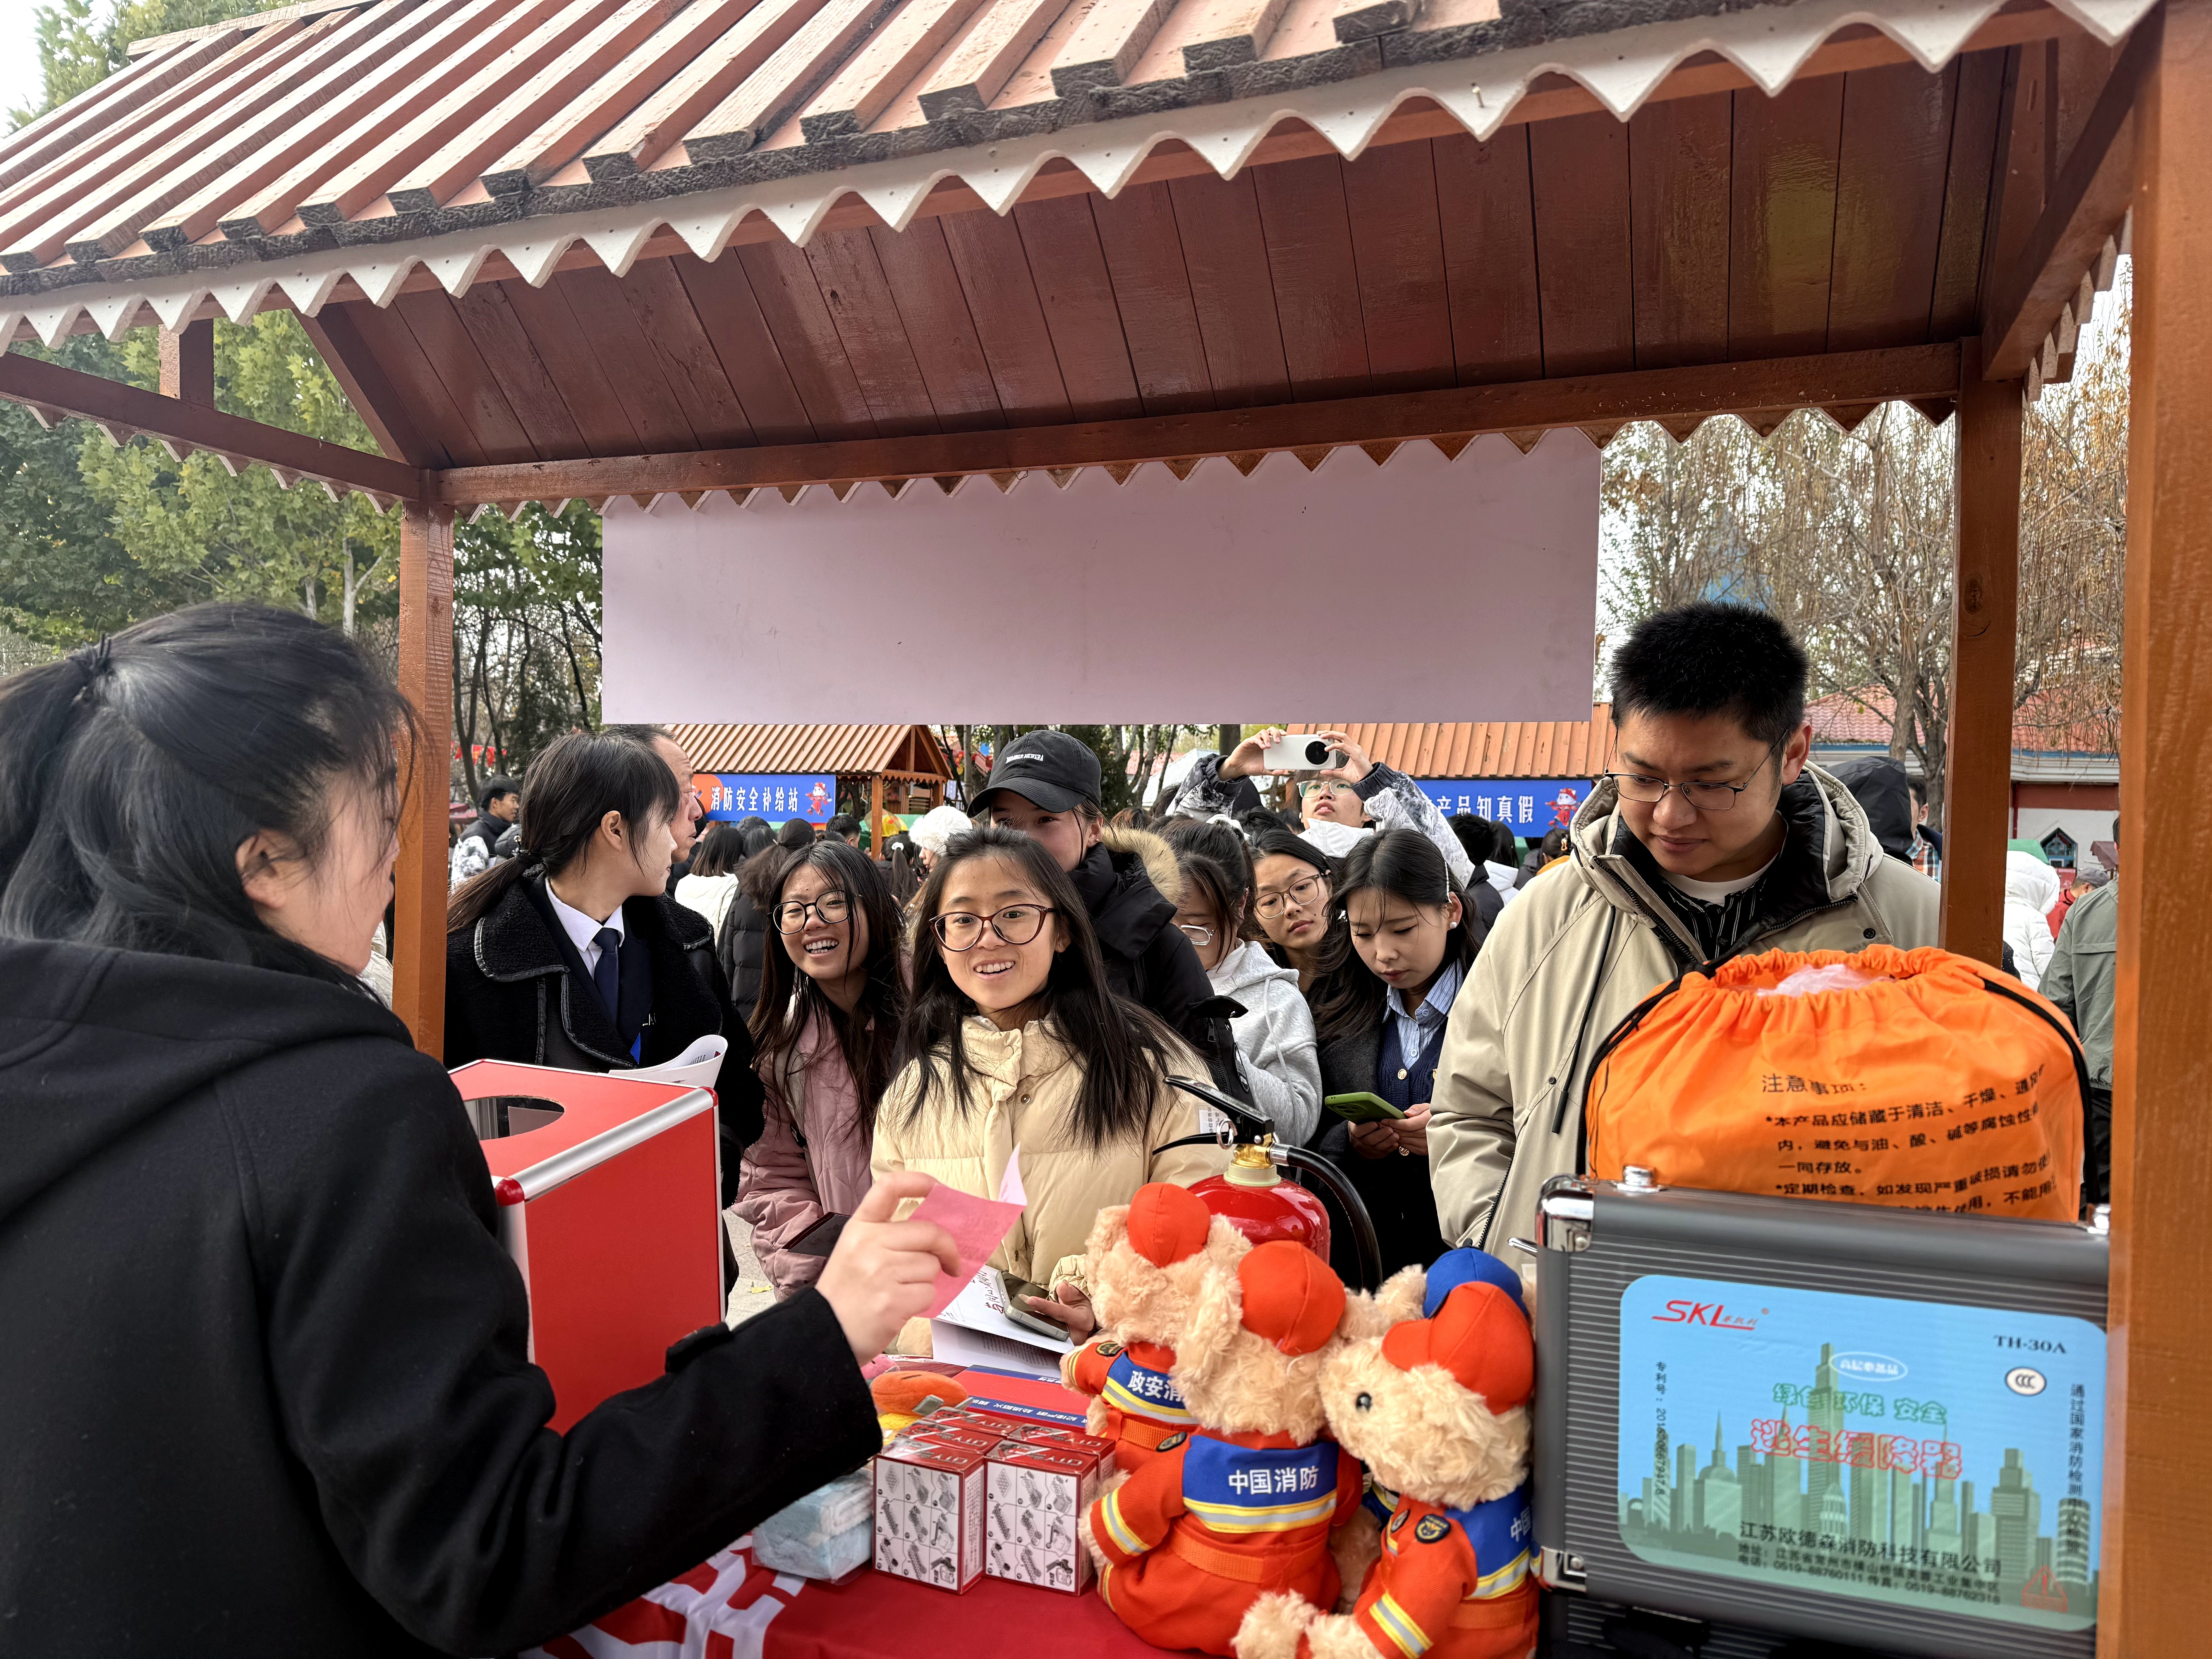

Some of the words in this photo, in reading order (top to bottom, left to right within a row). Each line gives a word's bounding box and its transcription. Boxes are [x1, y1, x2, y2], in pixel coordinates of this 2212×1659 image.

[711, 786, 798, 812] 消防安全补给站
[1430, 795, 1533, 823] 产品知真假
[1762, 1073, 1867, 1095] 注意事项：
[1766, 1063, 2045, 1127] 本产品应储藏于清洁、干燥、通风
[1778, 1101, 2039, 1151] 内，避免与油、酸、碱等腐蚀性
[1779, 1162, 1862, 1174] 一同存放。
[1651, 1300, 1755, 1331] SKL
[1994, 1335, 2066, 1354] TH-30A
[1833, 1391, 1885, 1417] 环保
[1894, 1398, 1947, 1425] 安全
[953, 1434, 988, 1448] CITY
[1068, 1436, 1102, 1448] CITY
[1750, 1419, 1962, 1480] 逃生缓降器
[931, 1454, 968, 1465] CITY
[1046, 1456, 1083, 1466] CITY
[1228, 1466, 1319, 1495] 中国消防
